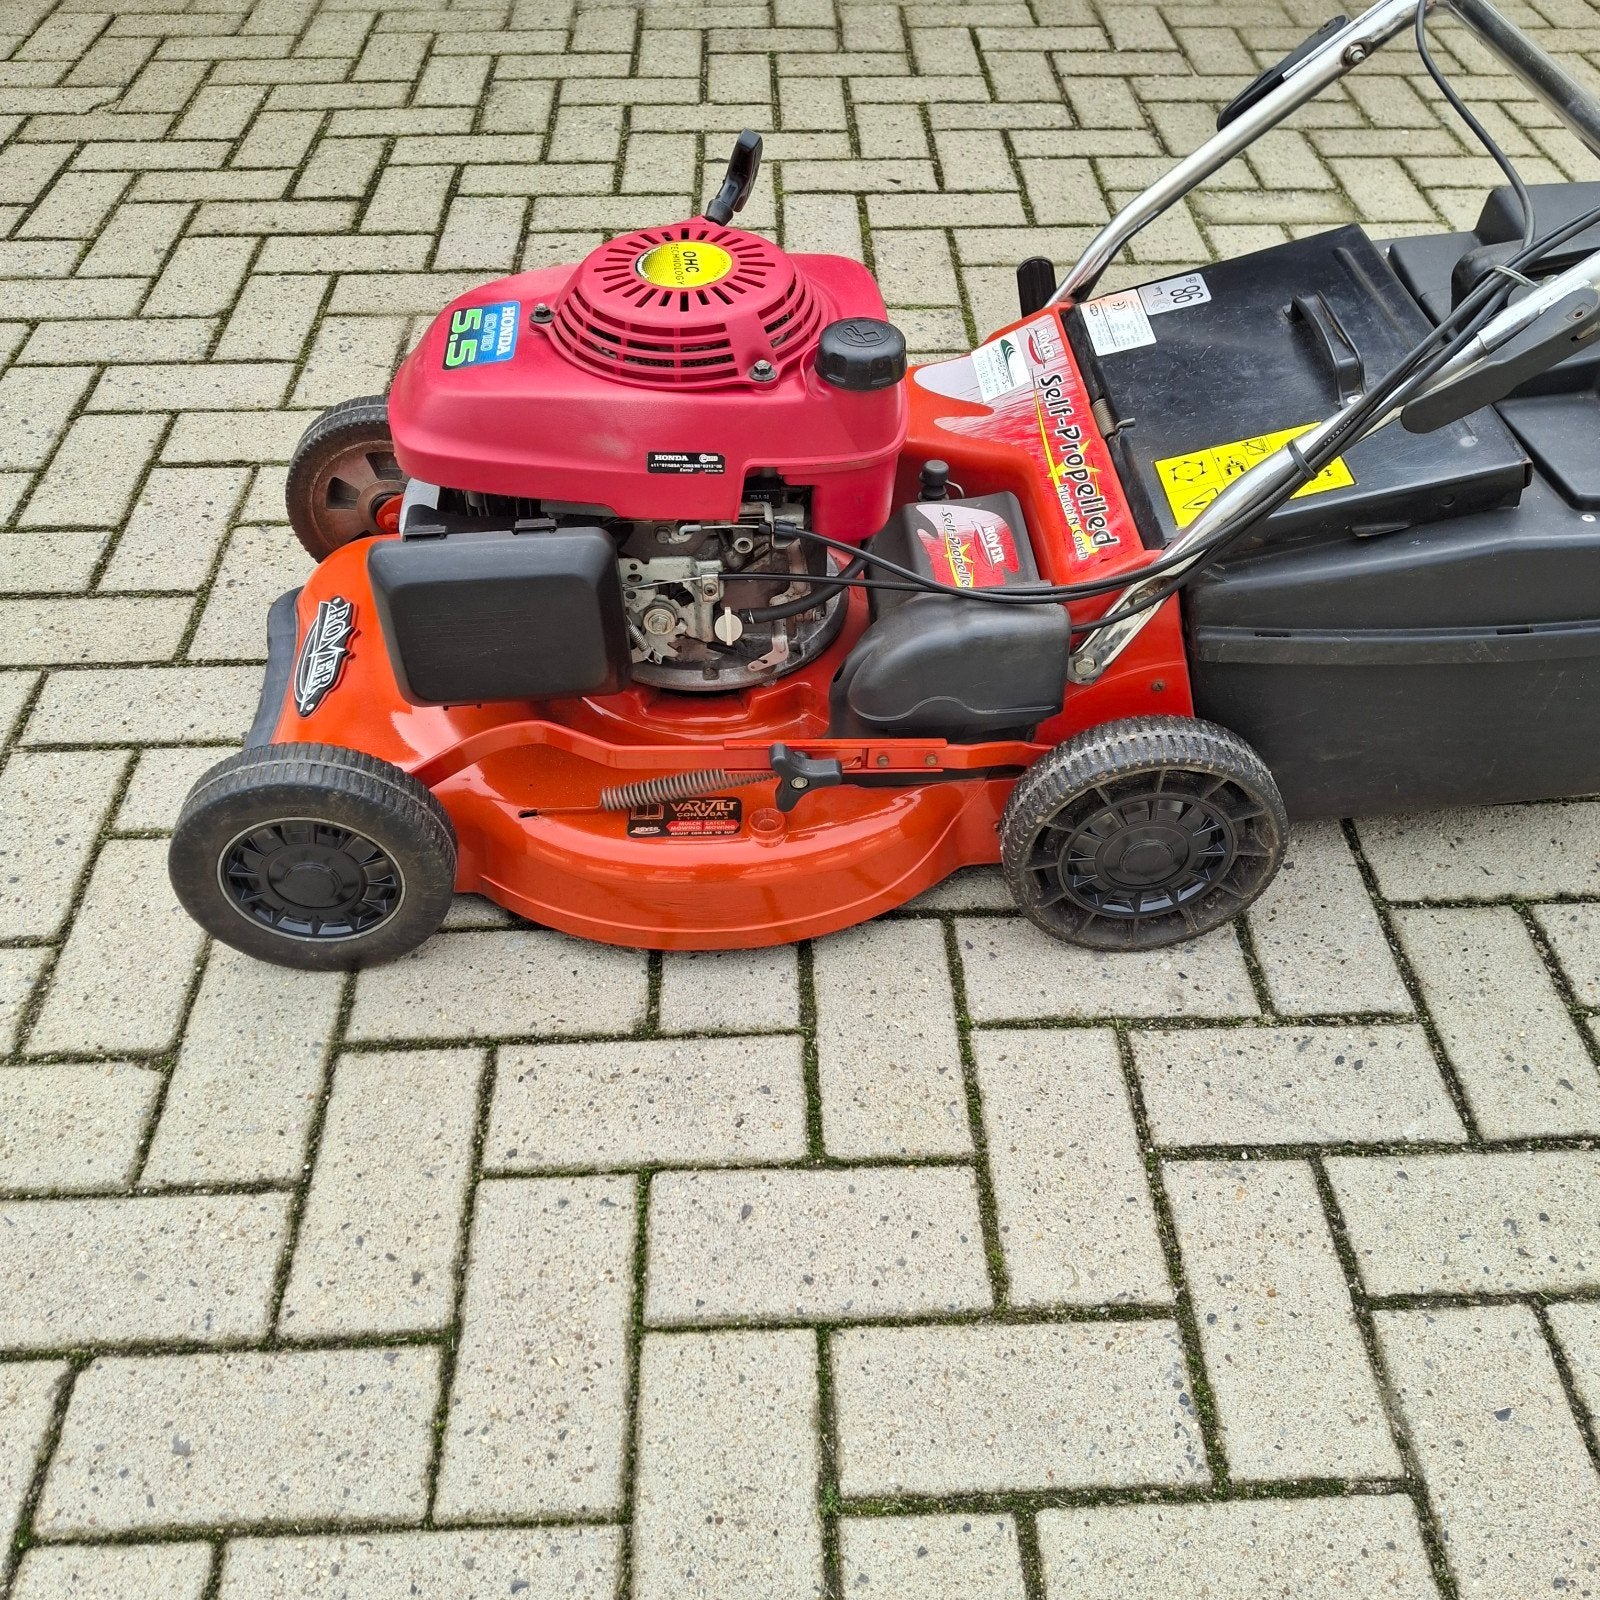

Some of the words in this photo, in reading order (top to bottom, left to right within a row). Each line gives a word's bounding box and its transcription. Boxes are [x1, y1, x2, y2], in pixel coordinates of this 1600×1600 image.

[683, 250, 700, 273] OHC
[1170, 285, 1204, 303] 98
[445, 308, 483, 367] 5.5
[496, 305, 516, 356] HONDA
[1035, 326, 1056, 361] ROVER
[1039, 373, 1119, 550] Self-Propelled
[1058, 484, 1075, 514] Mulch
[940, 511, 971, 588] Self-Propelle
[983, 525, 1005, 564] ROVER
[306, 602, 352, 695] ROVER
